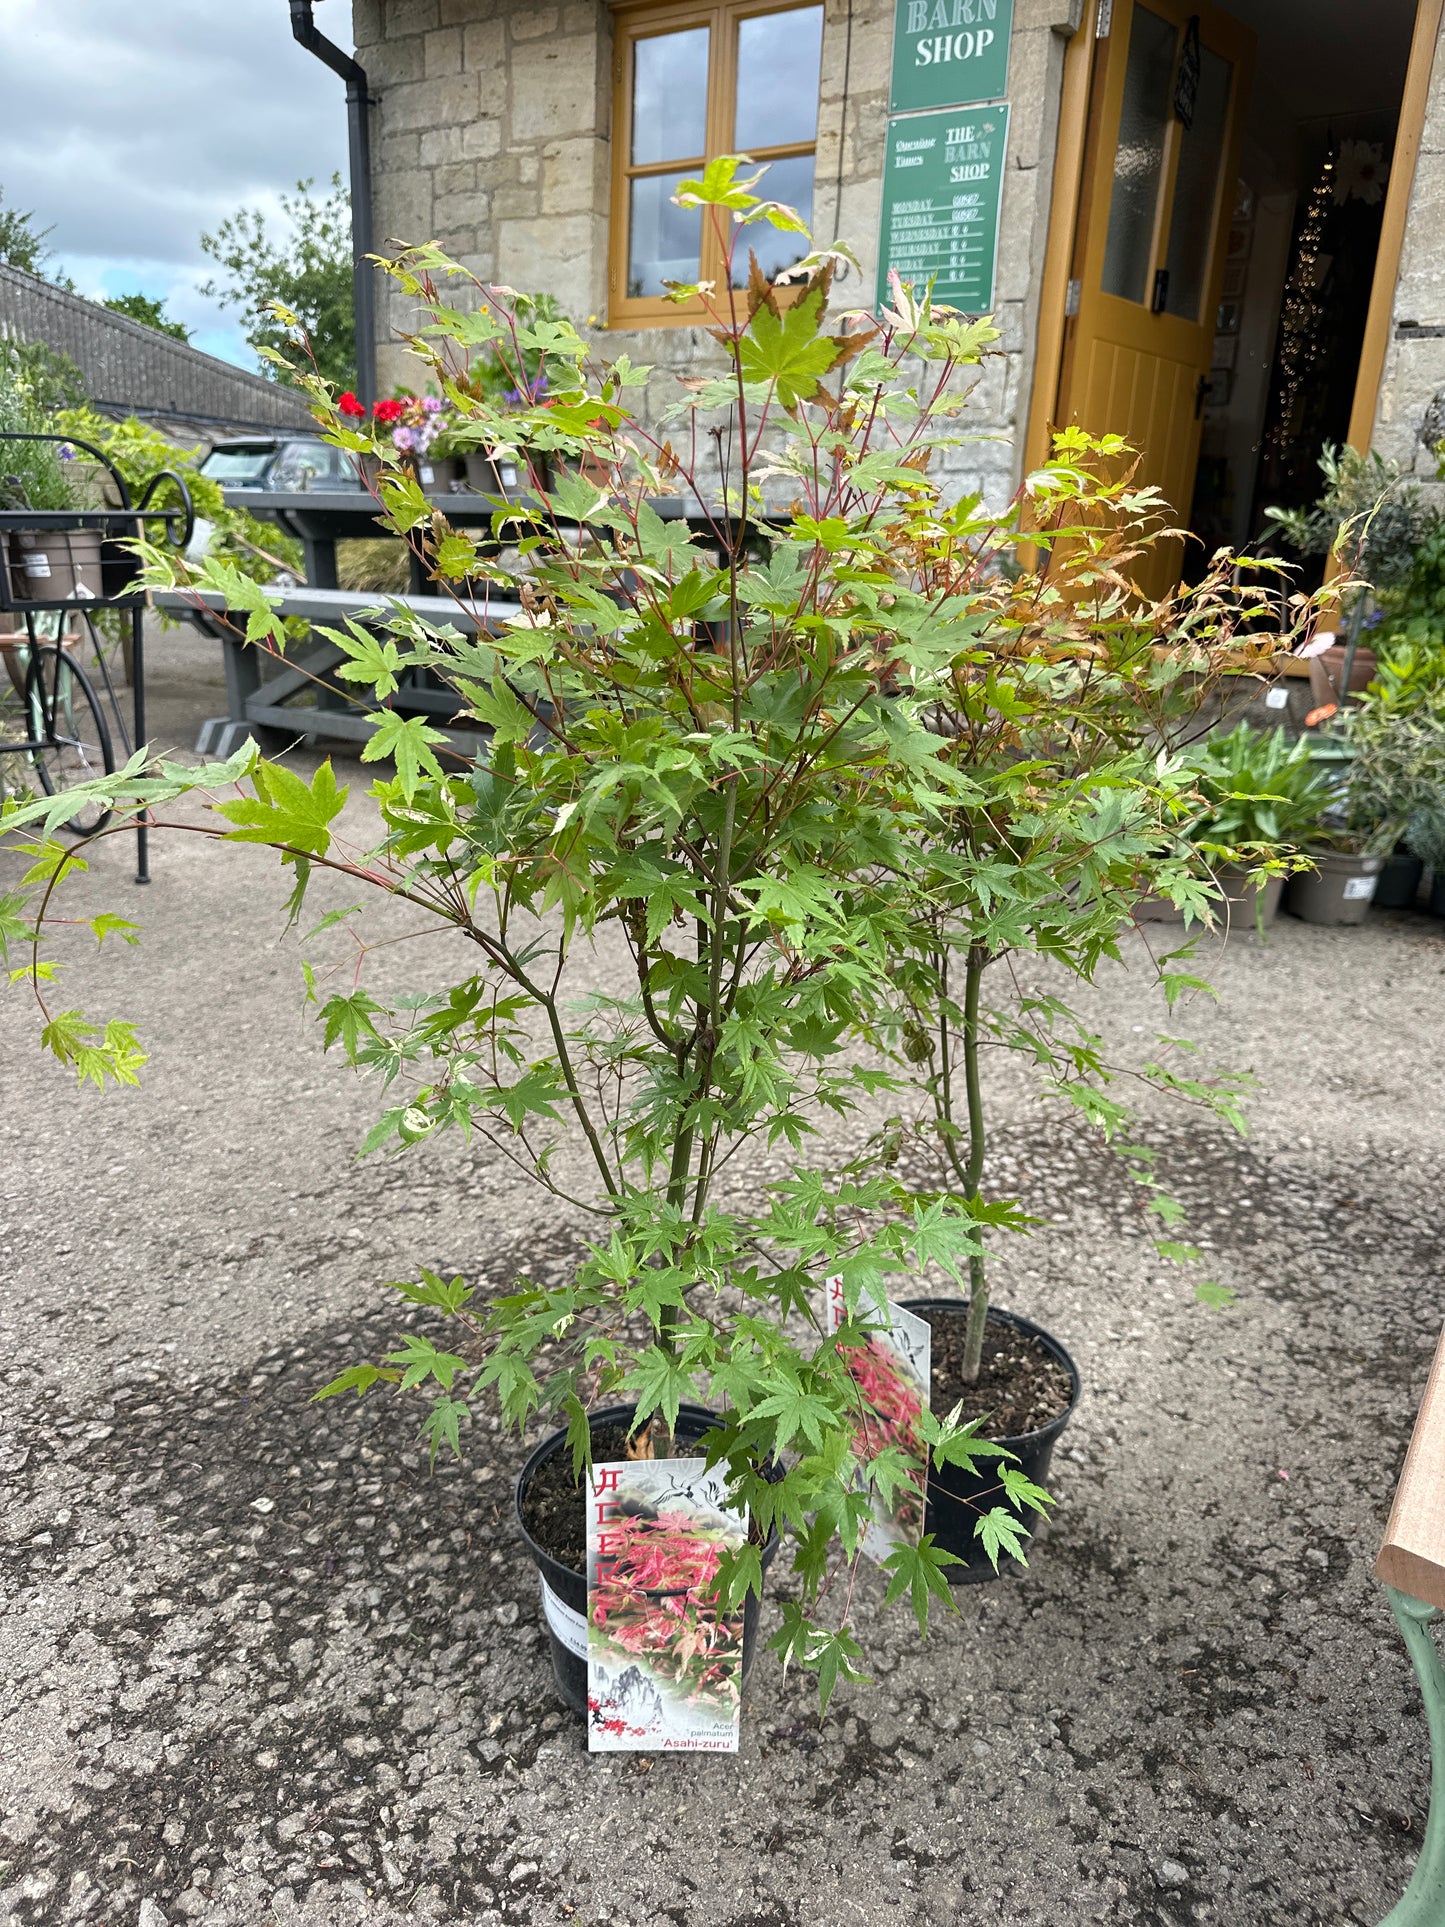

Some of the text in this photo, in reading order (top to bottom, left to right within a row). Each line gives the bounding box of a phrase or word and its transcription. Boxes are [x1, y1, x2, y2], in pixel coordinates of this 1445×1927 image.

[906, 0, 998, 34] BARN
[915, 29, 994, 66] SHOP
[945, 126, 975, 144] THE
[944, 141, 992, 163] BARN
[950, 163, 990, 182] SHOP
[690, 1729, 734, 1737] palmatum
[713, 1722, 734, 1730] Acer
[661, 1738, 733, 1748] 'Asahi-zuru'
